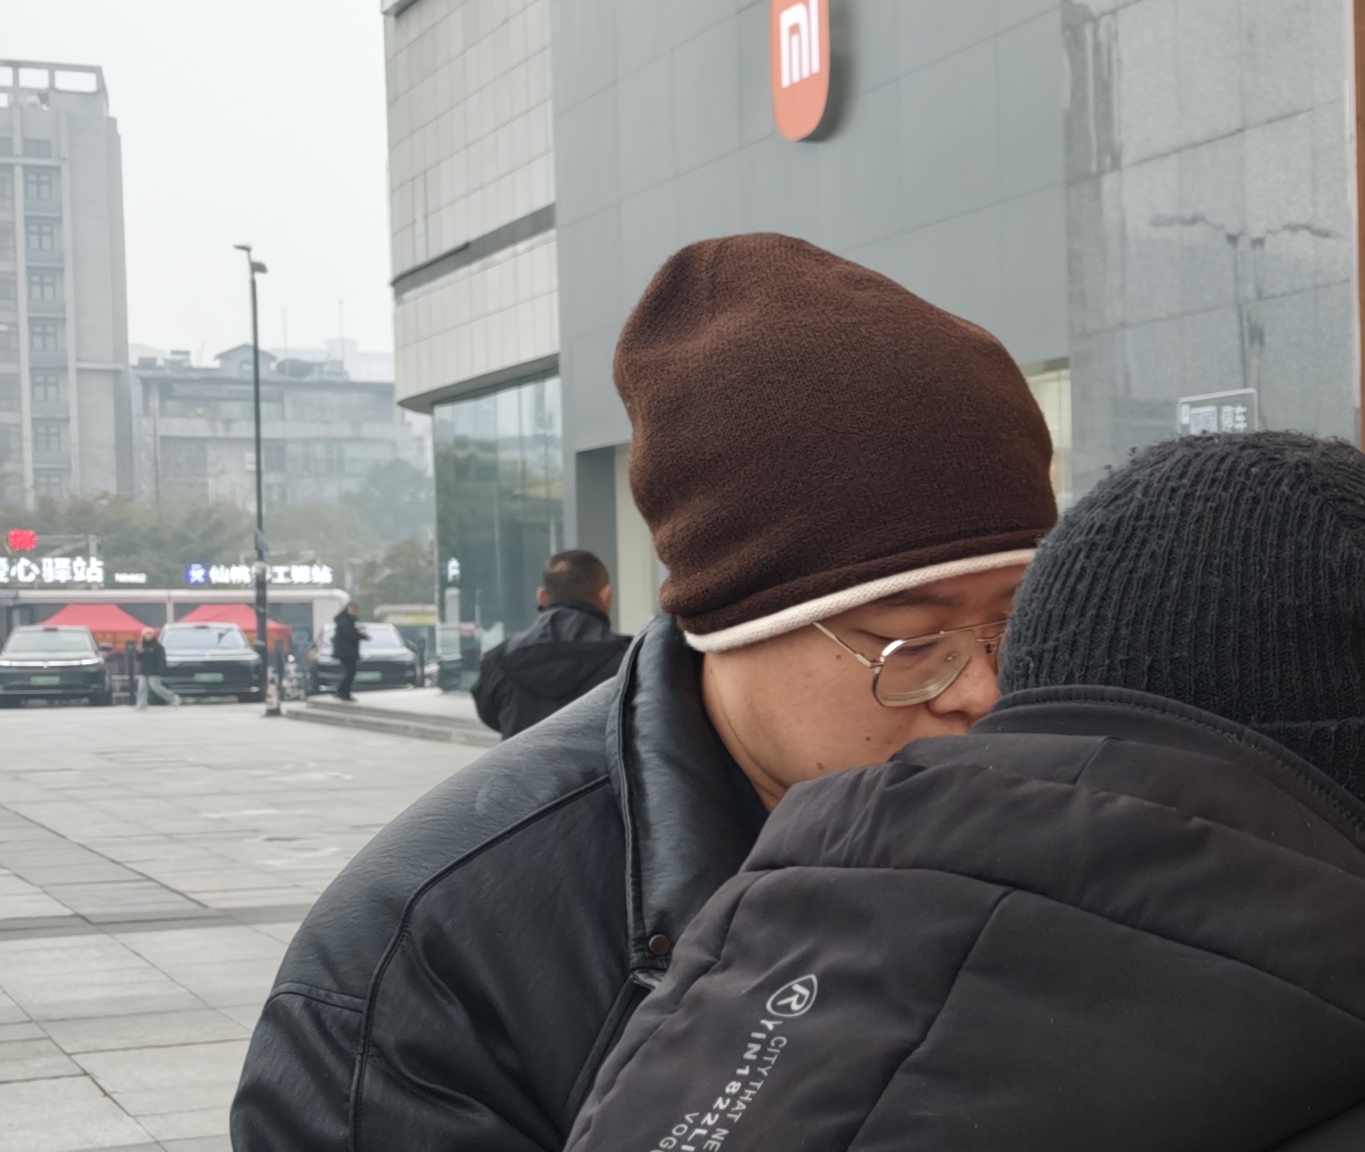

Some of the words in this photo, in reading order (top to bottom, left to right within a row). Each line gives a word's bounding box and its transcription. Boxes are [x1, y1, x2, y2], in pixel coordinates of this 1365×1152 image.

[210, 564, 333, 584] 仙桃工驿站
[757, 1036, 787, 1077] CITY
[727, 1079, 765, 1123] THAT
